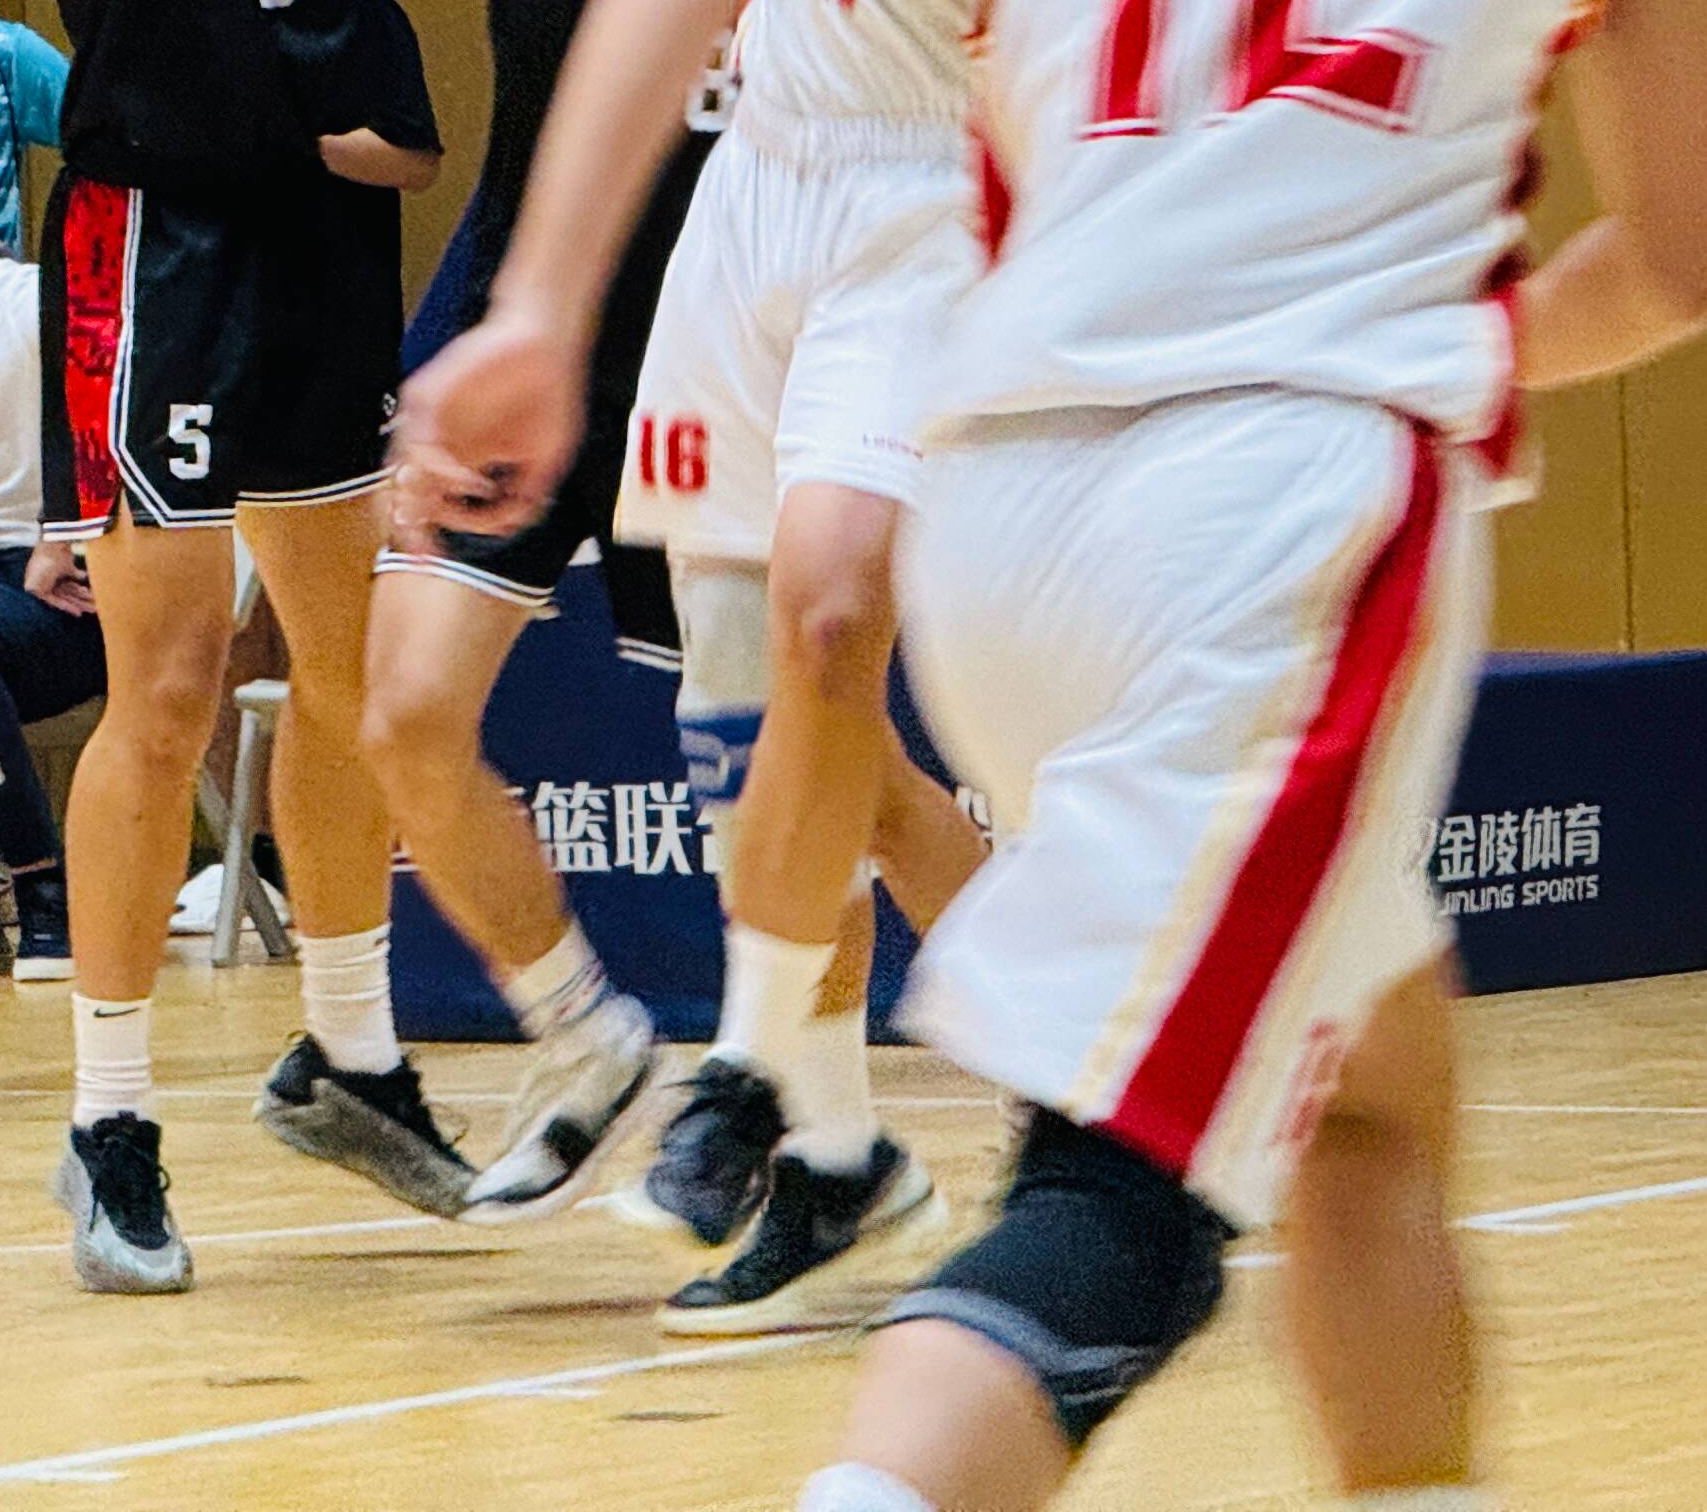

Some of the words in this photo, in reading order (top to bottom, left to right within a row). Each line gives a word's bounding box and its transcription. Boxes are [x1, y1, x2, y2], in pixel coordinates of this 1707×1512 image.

[167, 403, 214, 480] 5
[638, 414, 709, 493] 16
[1437, 803, 1602, 883] 金陵体育
[1522, 875, 1600, 906] SPORTS
